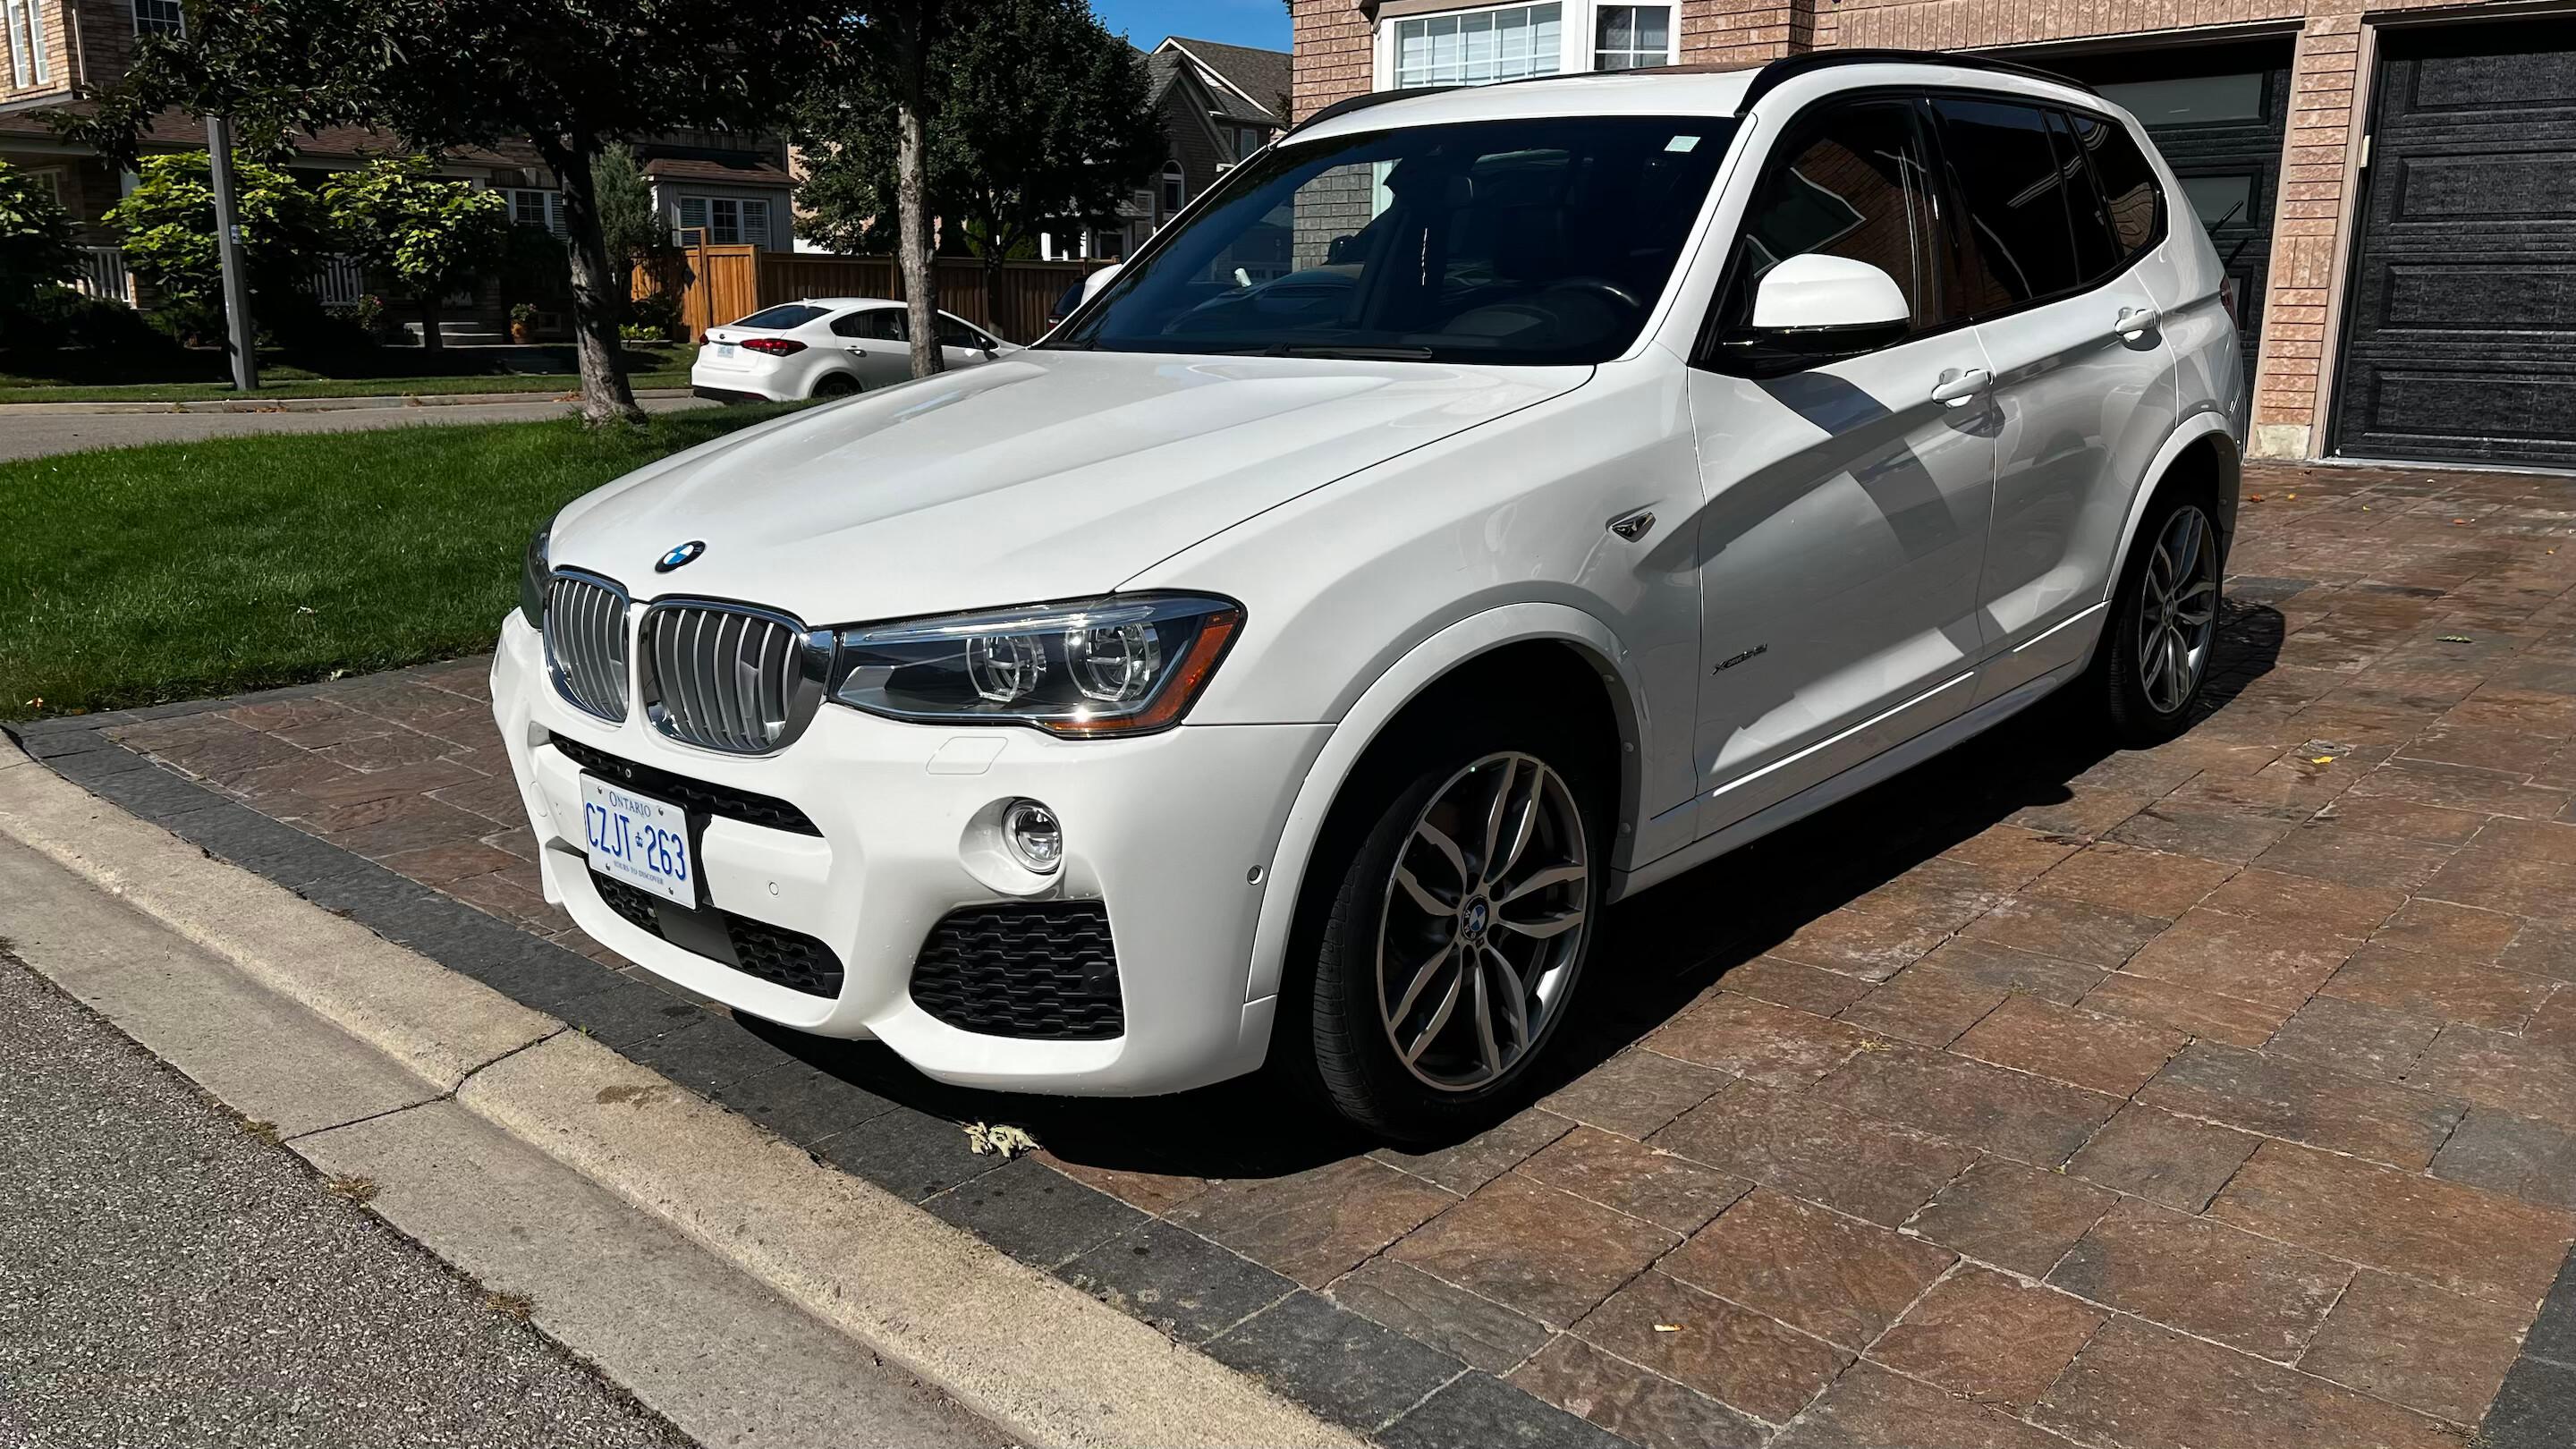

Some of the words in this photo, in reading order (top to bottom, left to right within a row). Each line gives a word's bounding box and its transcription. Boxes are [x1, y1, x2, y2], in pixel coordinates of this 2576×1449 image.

[609, 792, 651, 818] ONTARIO
[586, 802, 631, 861] CZJT
[645, 825, 686, 881] 263
[639, 869, 664, 885] DISCOVER
